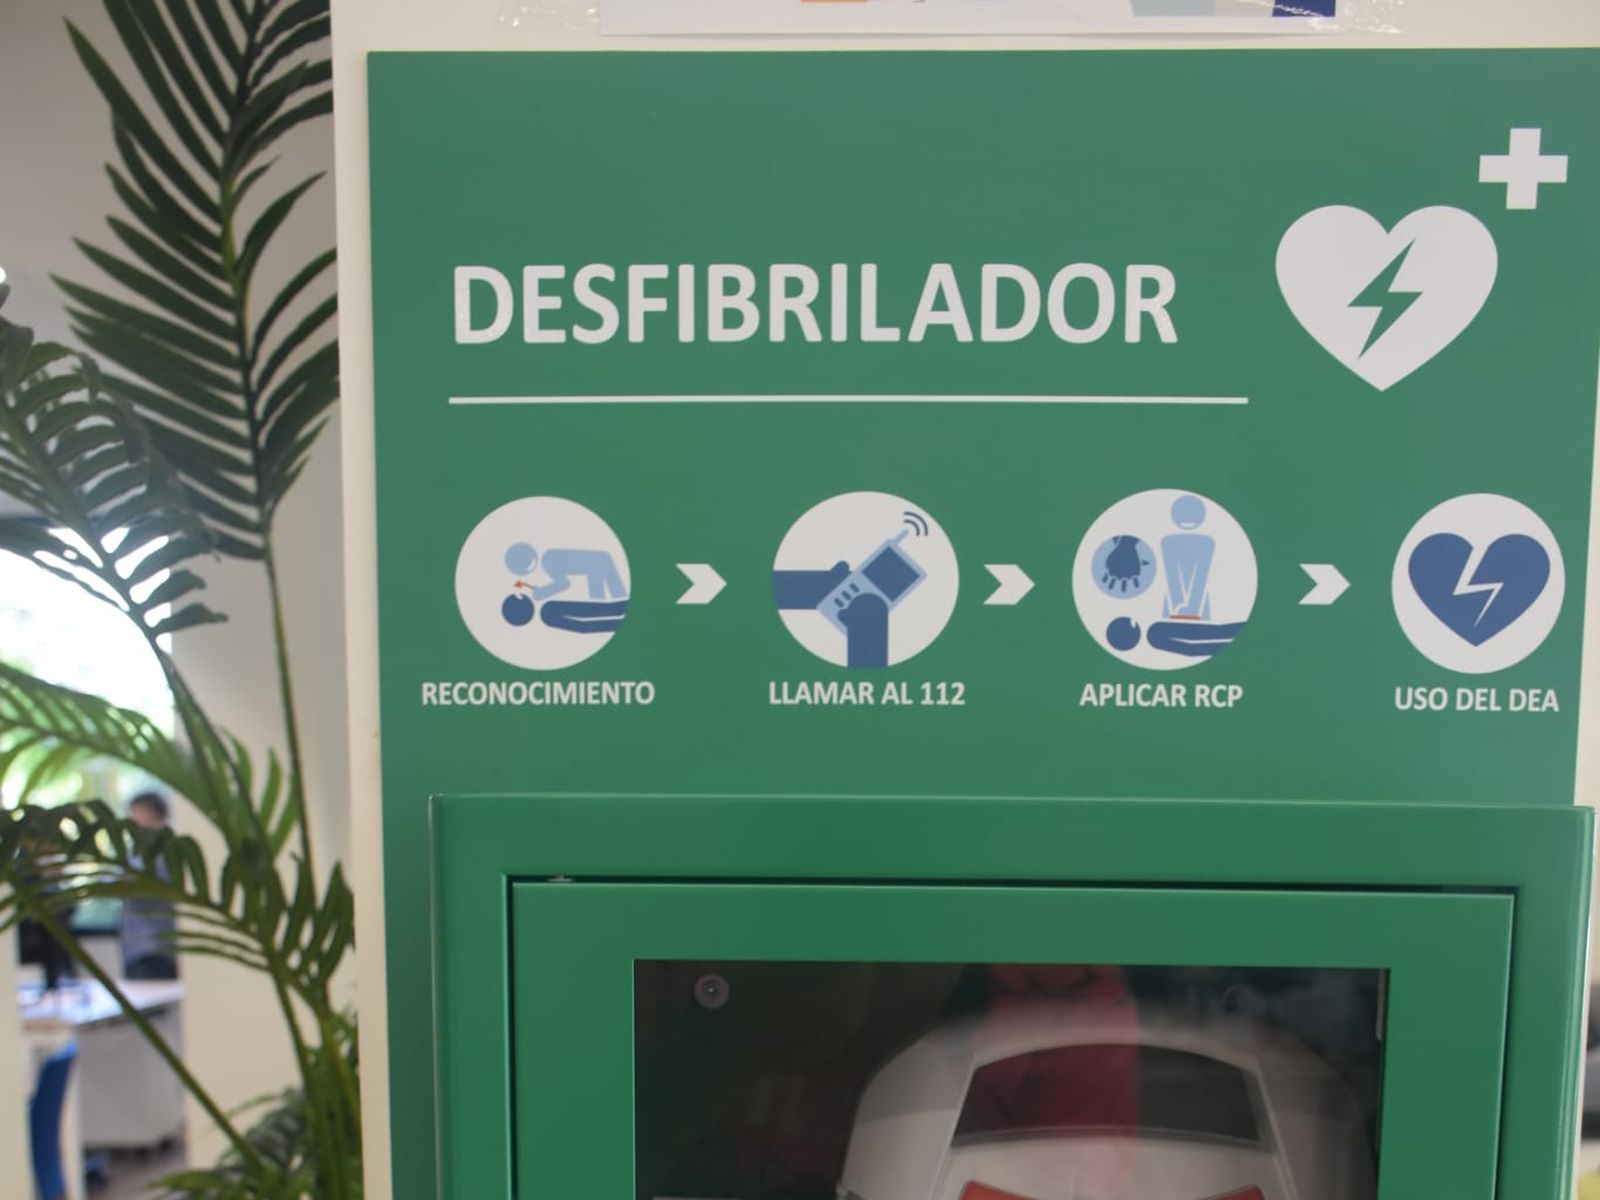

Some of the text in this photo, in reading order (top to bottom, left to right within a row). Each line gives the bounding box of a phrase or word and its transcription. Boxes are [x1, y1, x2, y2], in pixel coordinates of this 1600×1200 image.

[454, 262, 1178, 345] DESFIBRILADOR
[421, 681, 655, 706] RECONOCIMIENTO
[769, 681, 966, 706] LLAMAR AL 112
[1079, 683, 1243, 708] APLICAR RCP
[1394, 686, 1560, 713] USO DEL DEA
